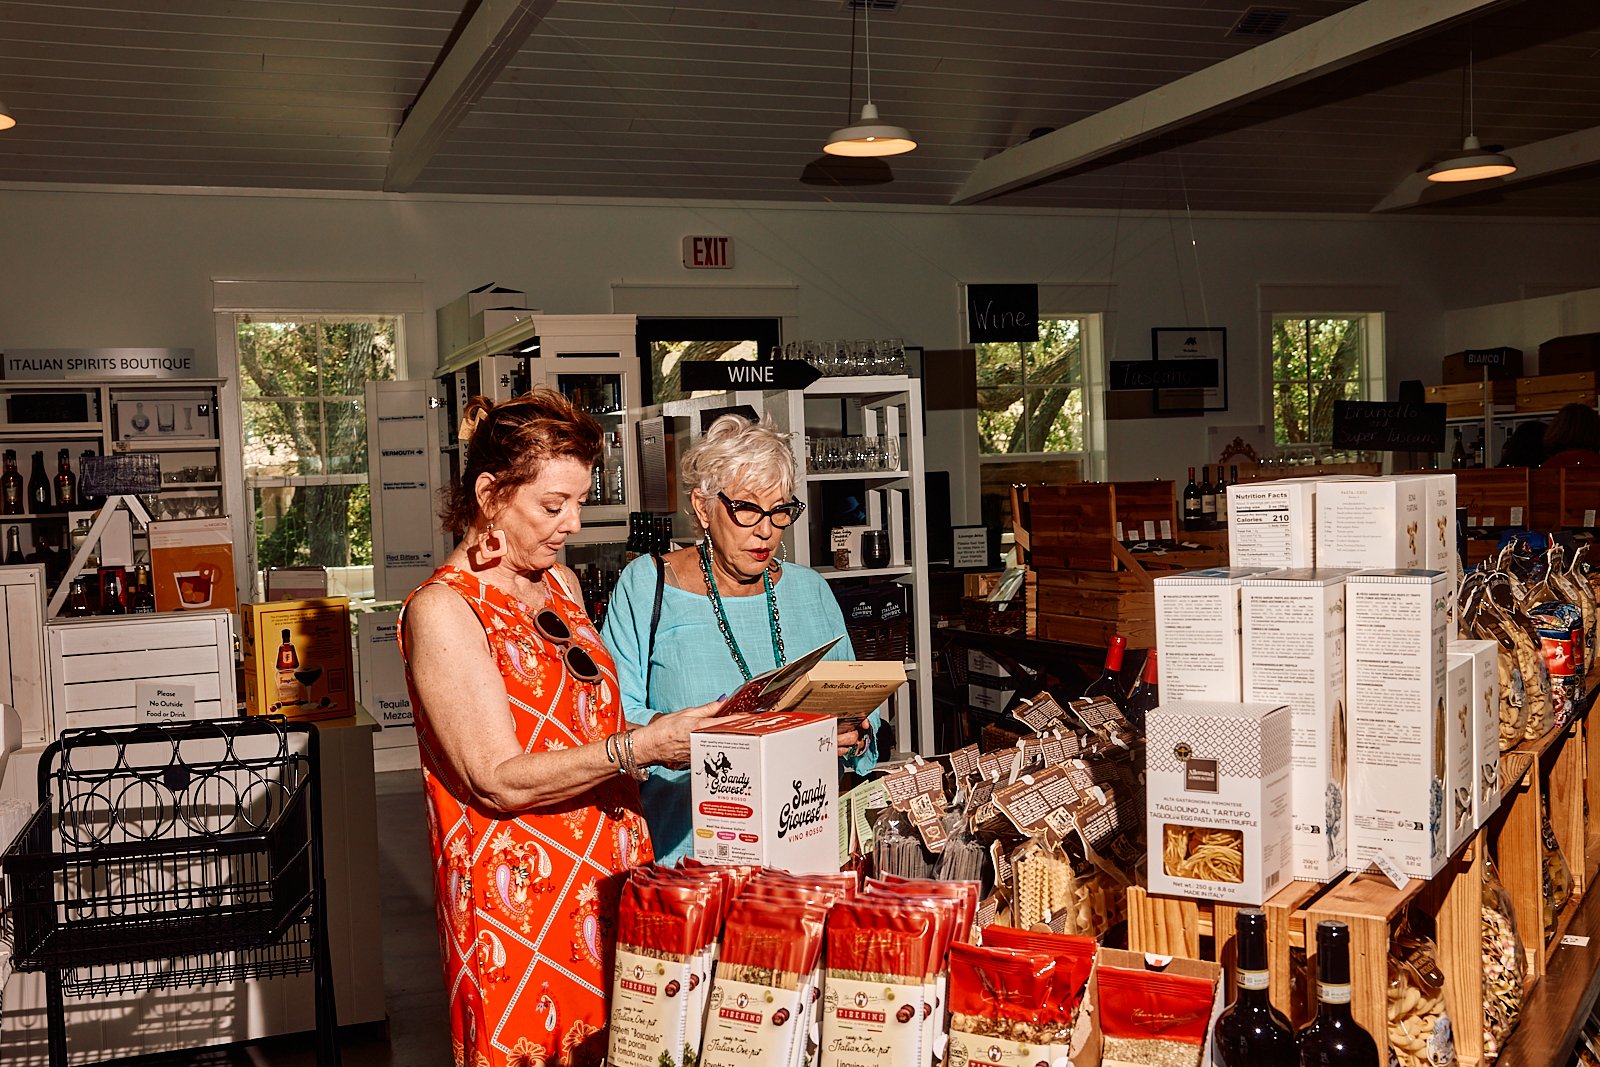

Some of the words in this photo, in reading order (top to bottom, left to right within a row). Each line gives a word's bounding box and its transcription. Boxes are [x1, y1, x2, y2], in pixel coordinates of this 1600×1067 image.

[693, 238, 728, 265] EXIT
[973, 299, 1030, 330] Wine
[9, 359, 63, 371] ITALIAN
[67, 358, 117, 370] SPIRITS
[121, 357, 191, 370] BOUTIQUE
[1468, 353, 1500, 364] BIANCO
[728, 366, 774, 382] WINE
[400, 553, 420, 561] Bitters
[379, 700, 410, 710] Tequila
[384, 711, 413, 720] Mezca
[720, 768, 750, 788] Sandy
[710, 778, 745, 795] Giovese
[792, 778, 827, 810] Sandy
[1156, 804, 1198, 813] TAGLIOLINO
[1213, 809, 1251, 818] TARTUFO
[777, 801, 822, 839] Giovese
[788, 833, 803, 843] VINO
[805, 826, 824, 838] ROSSO
[1184, 889, 1200, 897] MADE
[1208, 891, 1225, 899] ITALY
[621, 979, 656, 995] TIBERINO
[613, 1008, 634, 1022] Italian
[720, 1008, 761, 1022] TIBERINO
[838, 1009, 885, 1021] TIBERINO
[628, 1039, 647, 1050] porcini
[707, 1039, 735, 1052] Italian
[828, 1039, 860, 1052] Italian
[618, 1046, 636, 1058] tomato
[637, 1052, 653, 1063] sauce
